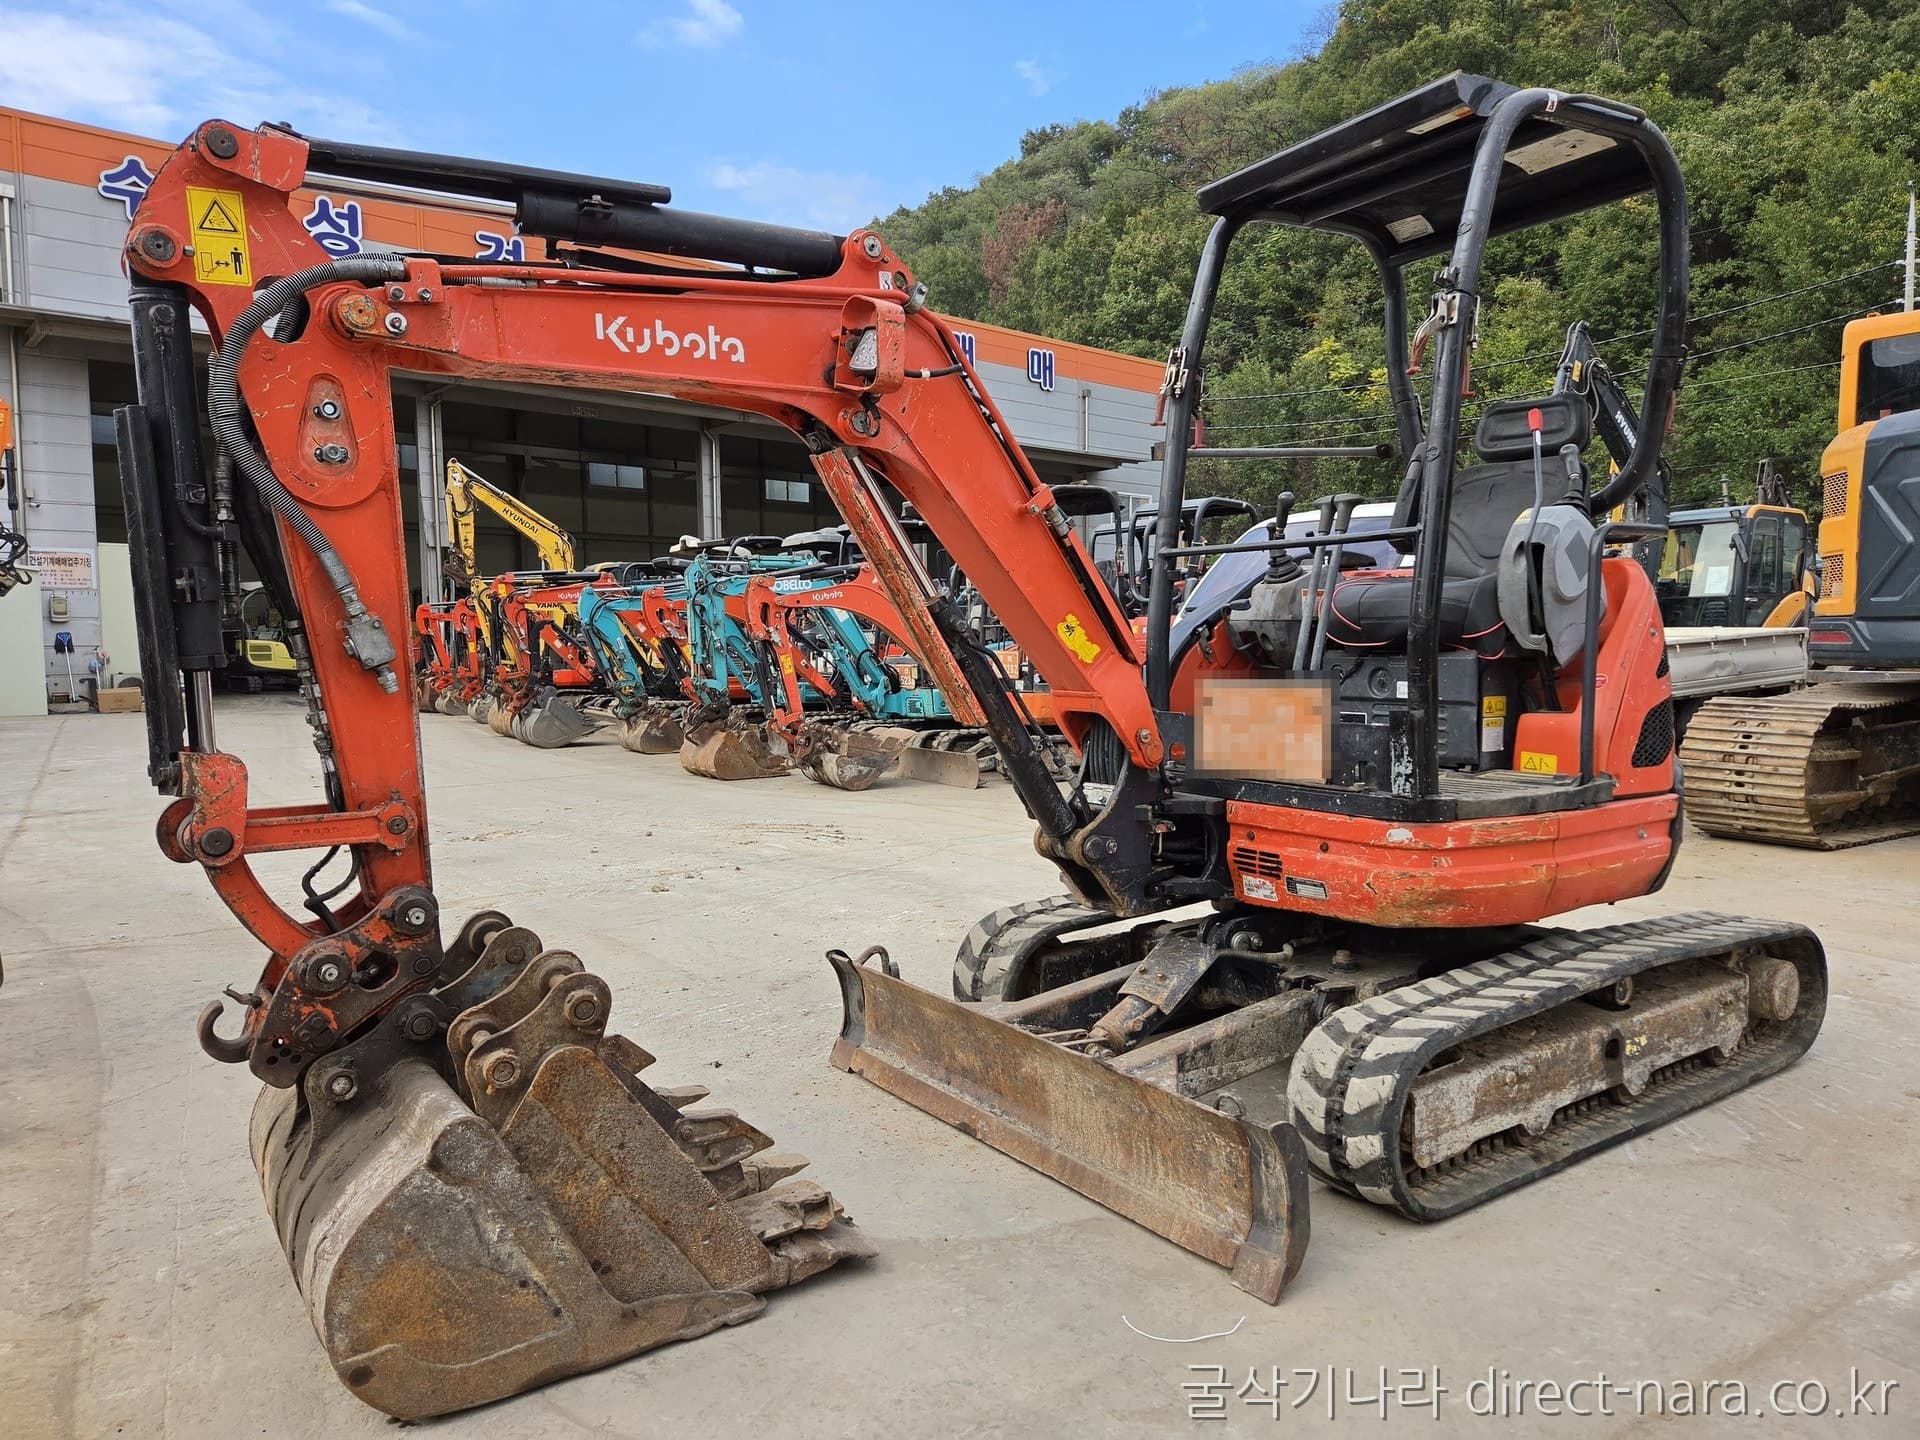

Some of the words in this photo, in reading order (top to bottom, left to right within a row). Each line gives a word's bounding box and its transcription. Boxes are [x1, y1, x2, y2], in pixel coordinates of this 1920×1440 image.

[303, 196, 361, 257] 성
[1028, 348, 1055, 391] 매
[594, 312, 745, 363] Kubota
[502, 507, 539, 534] HYUNDAI
[771, 580, 812, 591] OBELCO
[811, 591, 844, 602] Kubota
